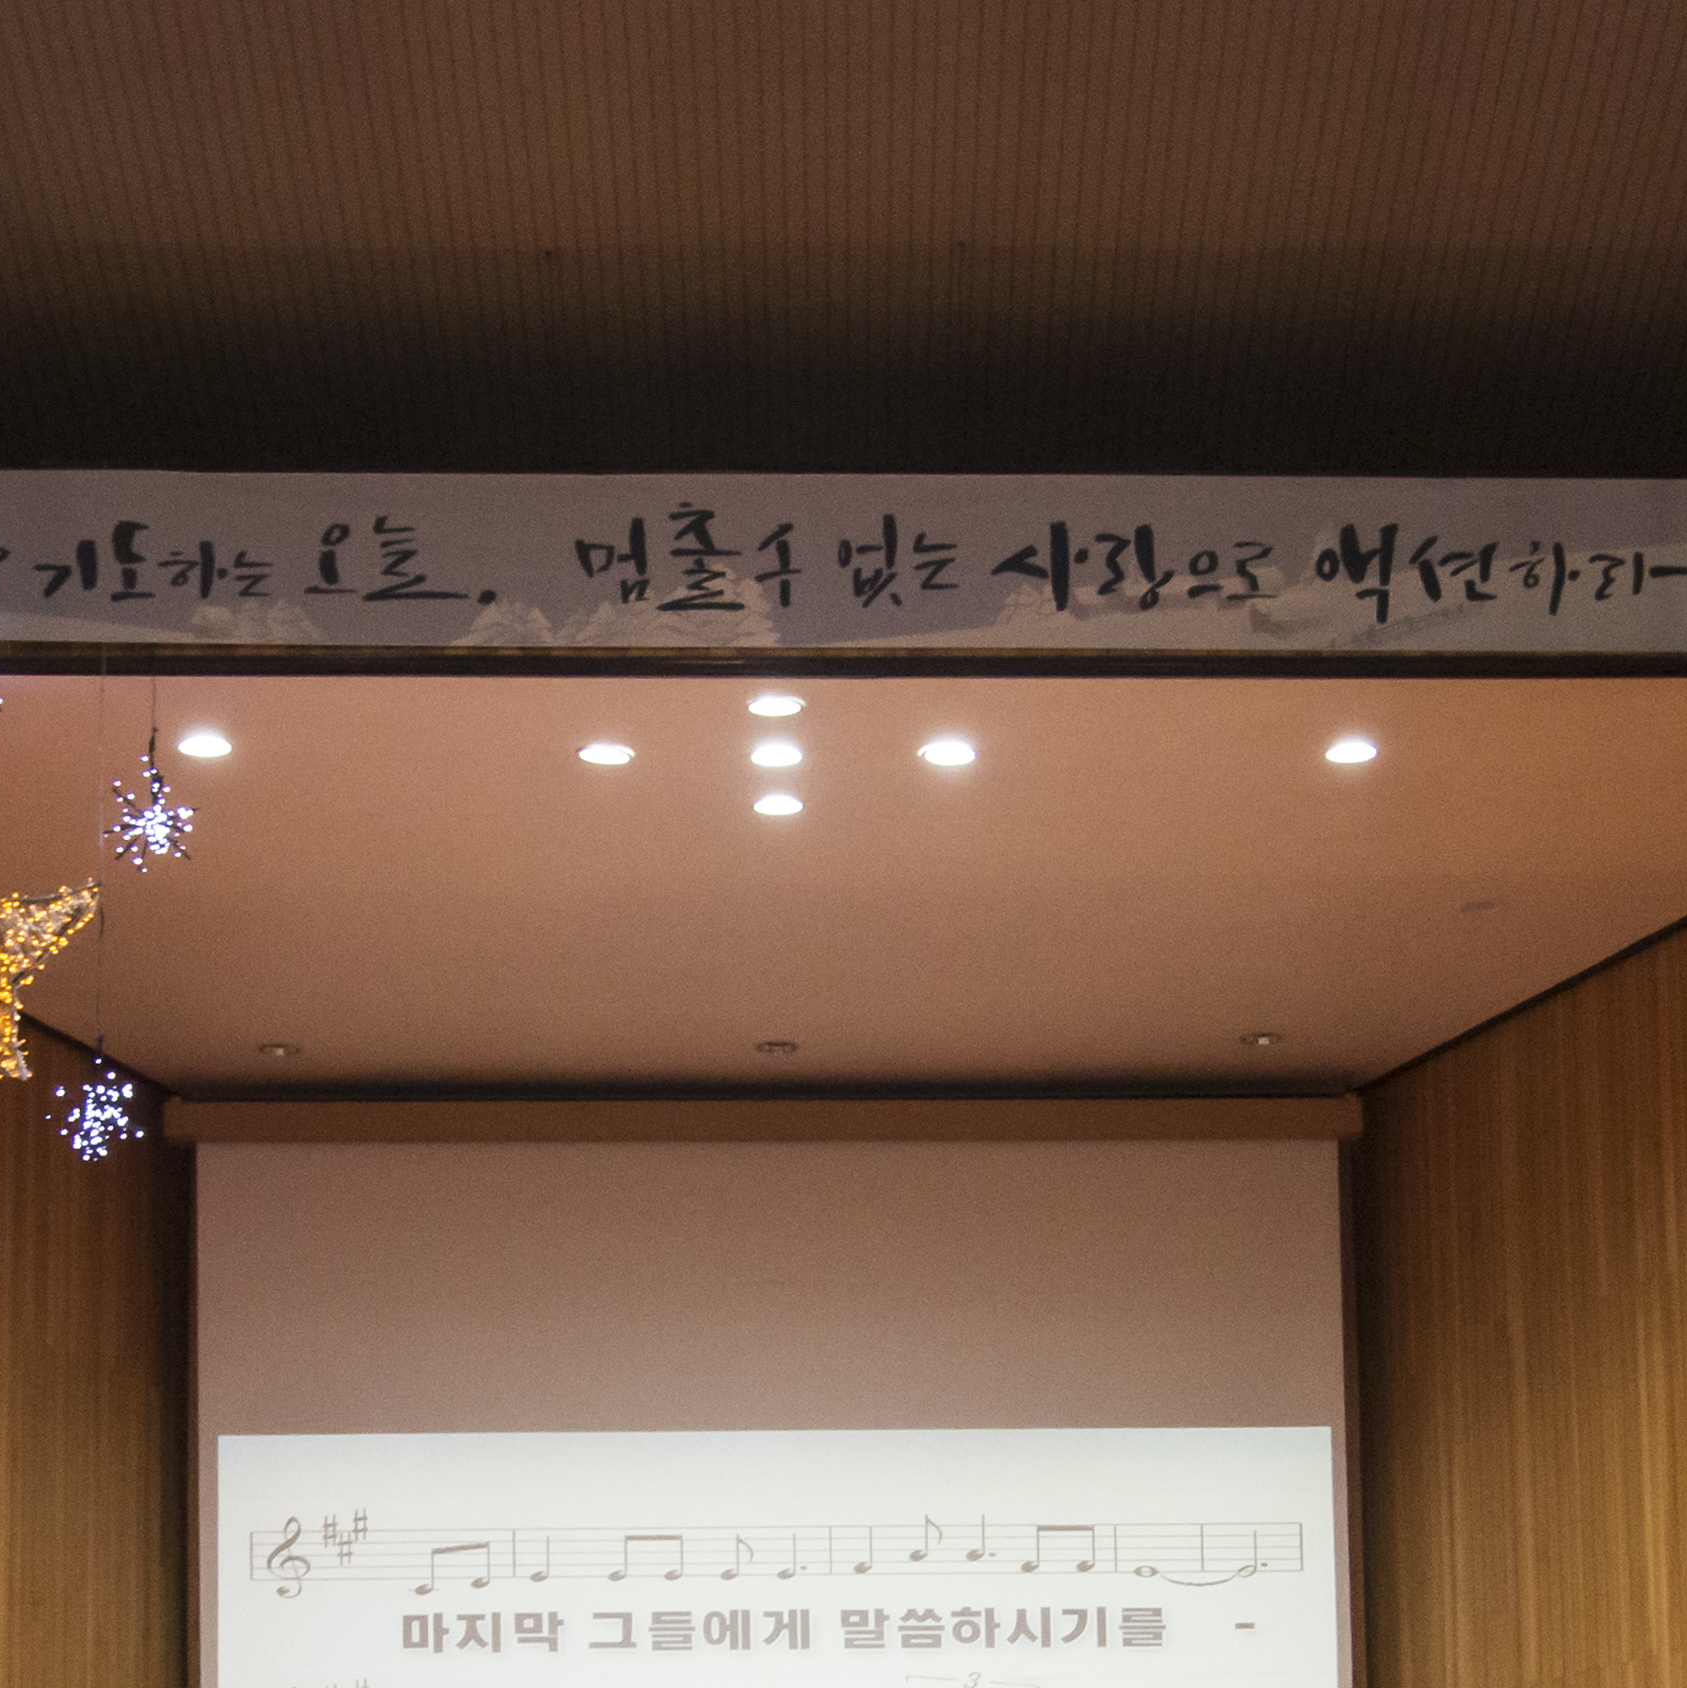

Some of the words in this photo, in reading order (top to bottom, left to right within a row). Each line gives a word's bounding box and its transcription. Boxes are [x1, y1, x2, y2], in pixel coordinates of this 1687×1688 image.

[33, 520, 274, 601] 기도하는
[837, 513, 960, 608] 없는
[992, 520, 1278, 612] 사랑으로
[402, 1610, 566, 1654] 마지막
[587, 1608, 812, 1652] 그들에게
[840, 1606, 1169, 1651] 말씀하시기를
